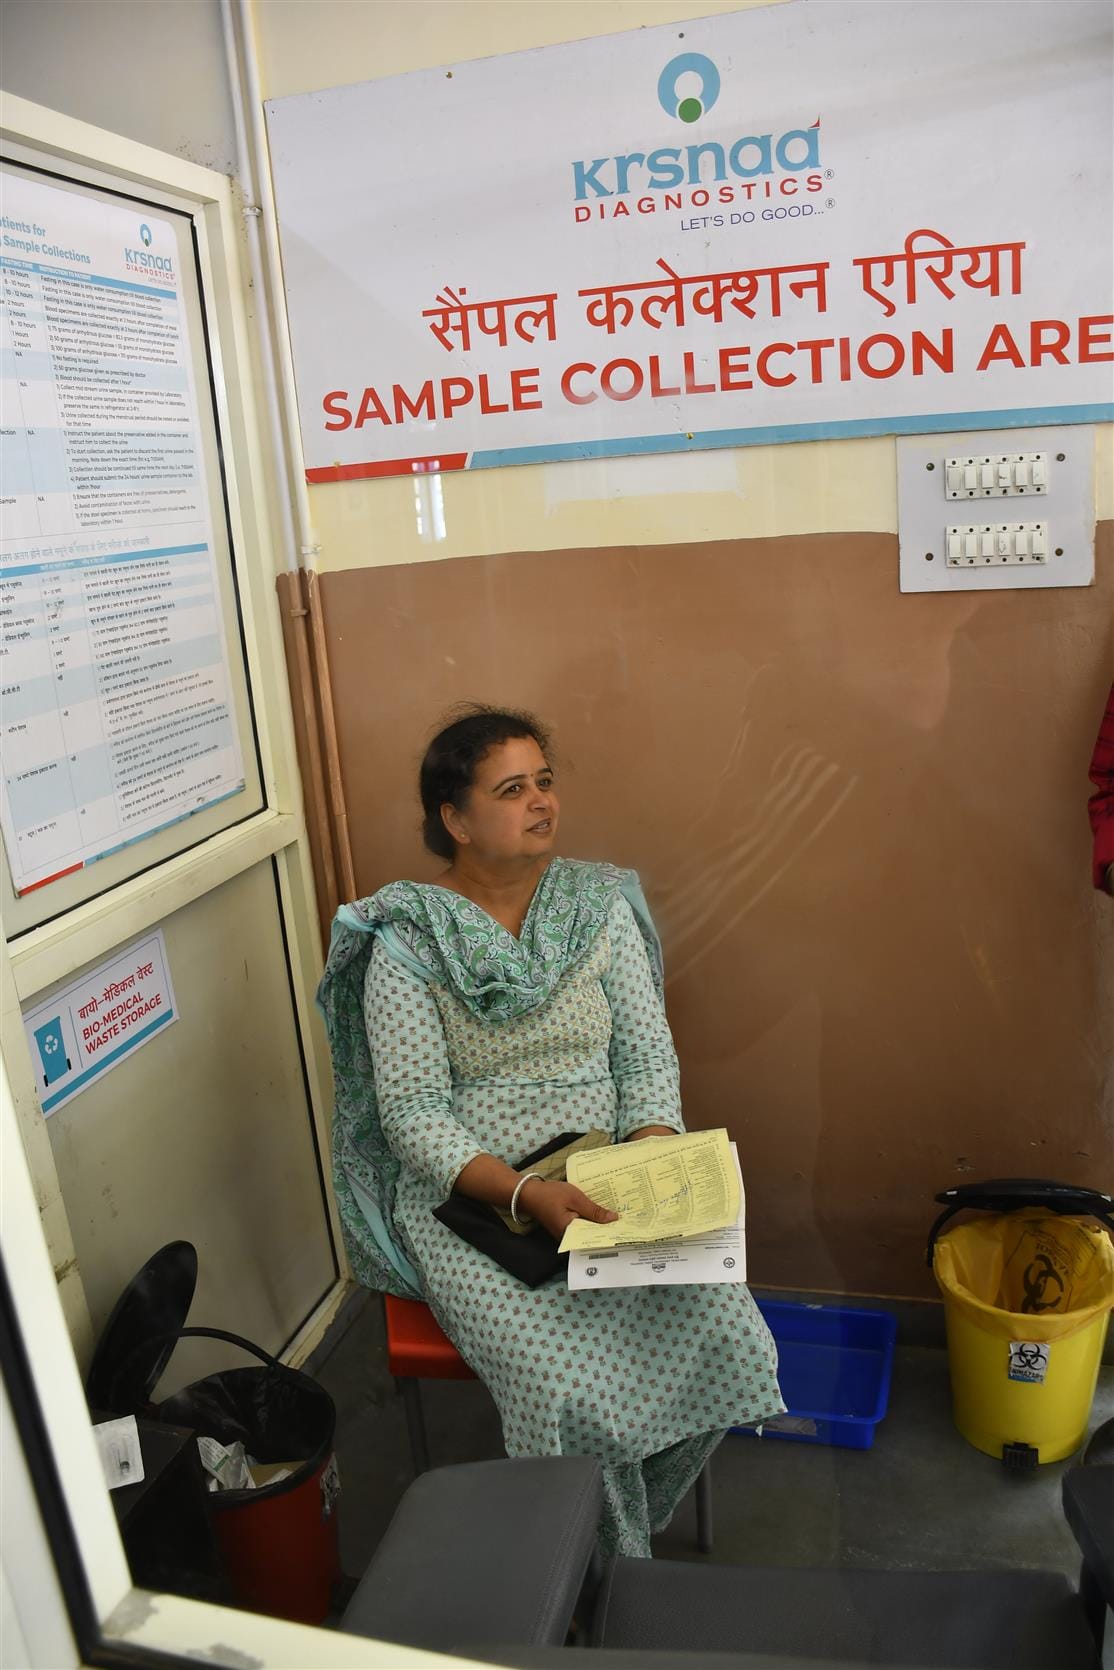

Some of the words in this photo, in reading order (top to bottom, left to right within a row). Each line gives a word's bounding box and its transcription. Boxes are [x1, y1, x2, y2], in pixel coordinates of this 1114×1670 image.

[0, 216, 31, 234] tients
[33, 224, 46, 237] for
[680, 214, 725, 231] LET'S
[730, 210, 756, 226] DO
[3, 235, 40, 253] Sample
[42, 243, 91, 264] Collections
[422, 286, 558, 353] सैंपल
[578, 258, 830, 335] कलेक्शन
[853, 228, 1027, 318] एरिया
[321, 366, 544, 432] SAMPLE
[560, 326, 955, 406] COLLECTION
[136, 962, 154, 981] वेस्ट
[82, 991, 144, 1041] BIO-MEDICAL
[85, 1023, 121, 1055] WASTE
[120, 993, 163, 1032] STORAGE
